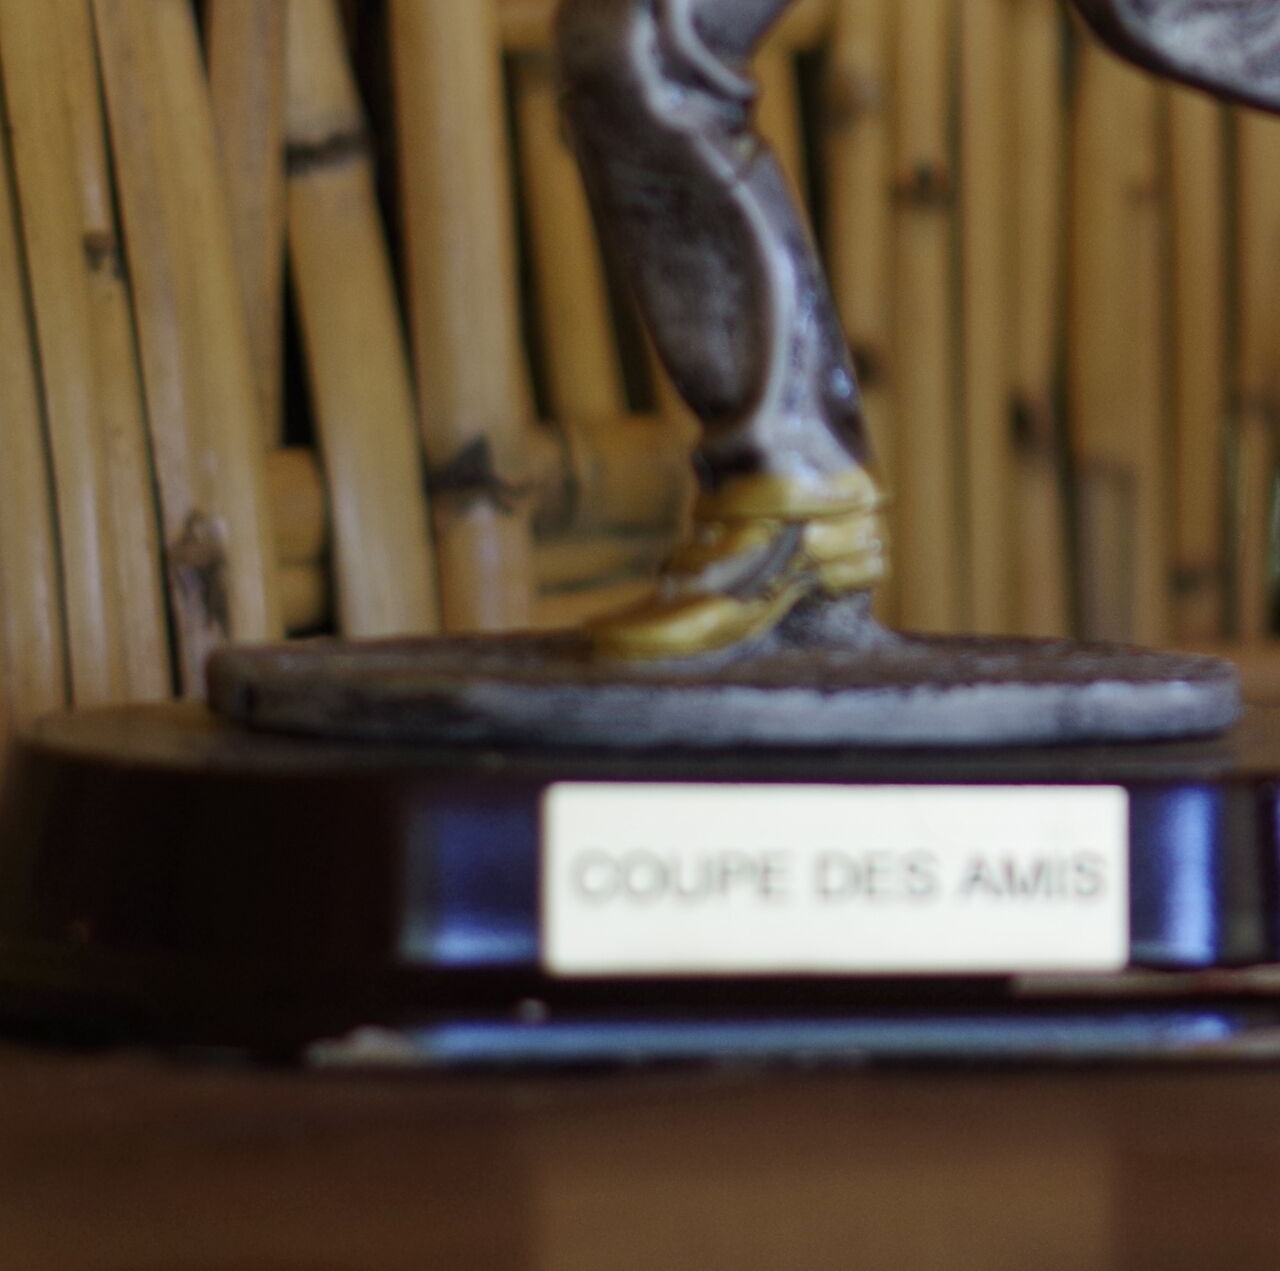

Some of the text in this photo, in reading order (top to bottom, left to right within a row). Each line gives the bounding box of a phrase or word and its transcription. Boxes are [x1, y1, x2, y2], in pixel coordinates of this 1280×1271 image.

[571, 846, 1108, 906] COUPE DES AMIS
